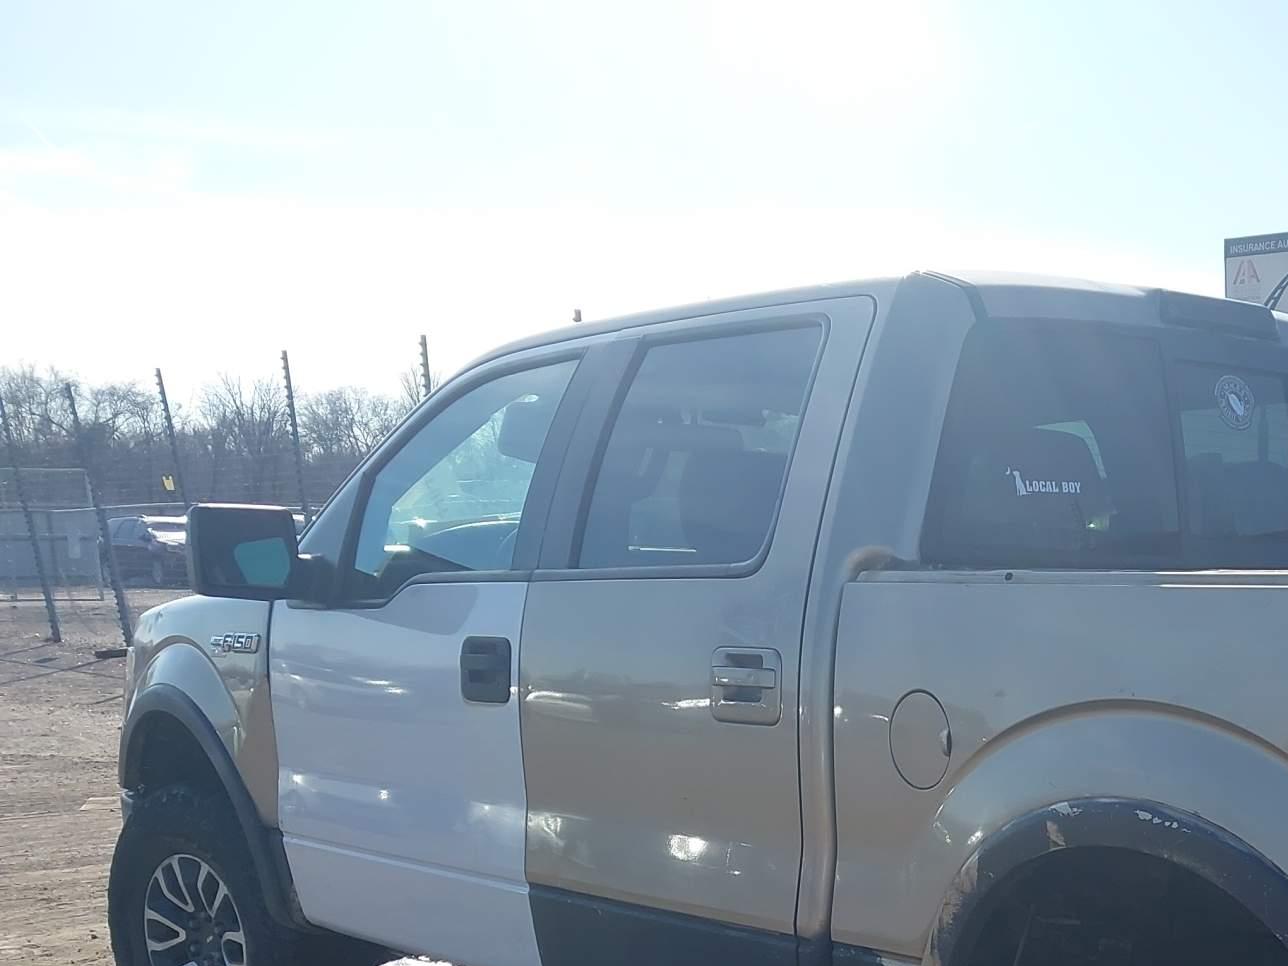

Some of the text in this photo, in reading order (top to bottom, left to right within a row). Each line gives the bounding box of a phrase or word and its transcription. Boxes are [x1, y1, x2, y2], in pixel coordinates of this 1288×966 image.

[1230, 240, 1276, 254] INSURANCE
[1025, 480, 1081, 493] LOCAL BOY
